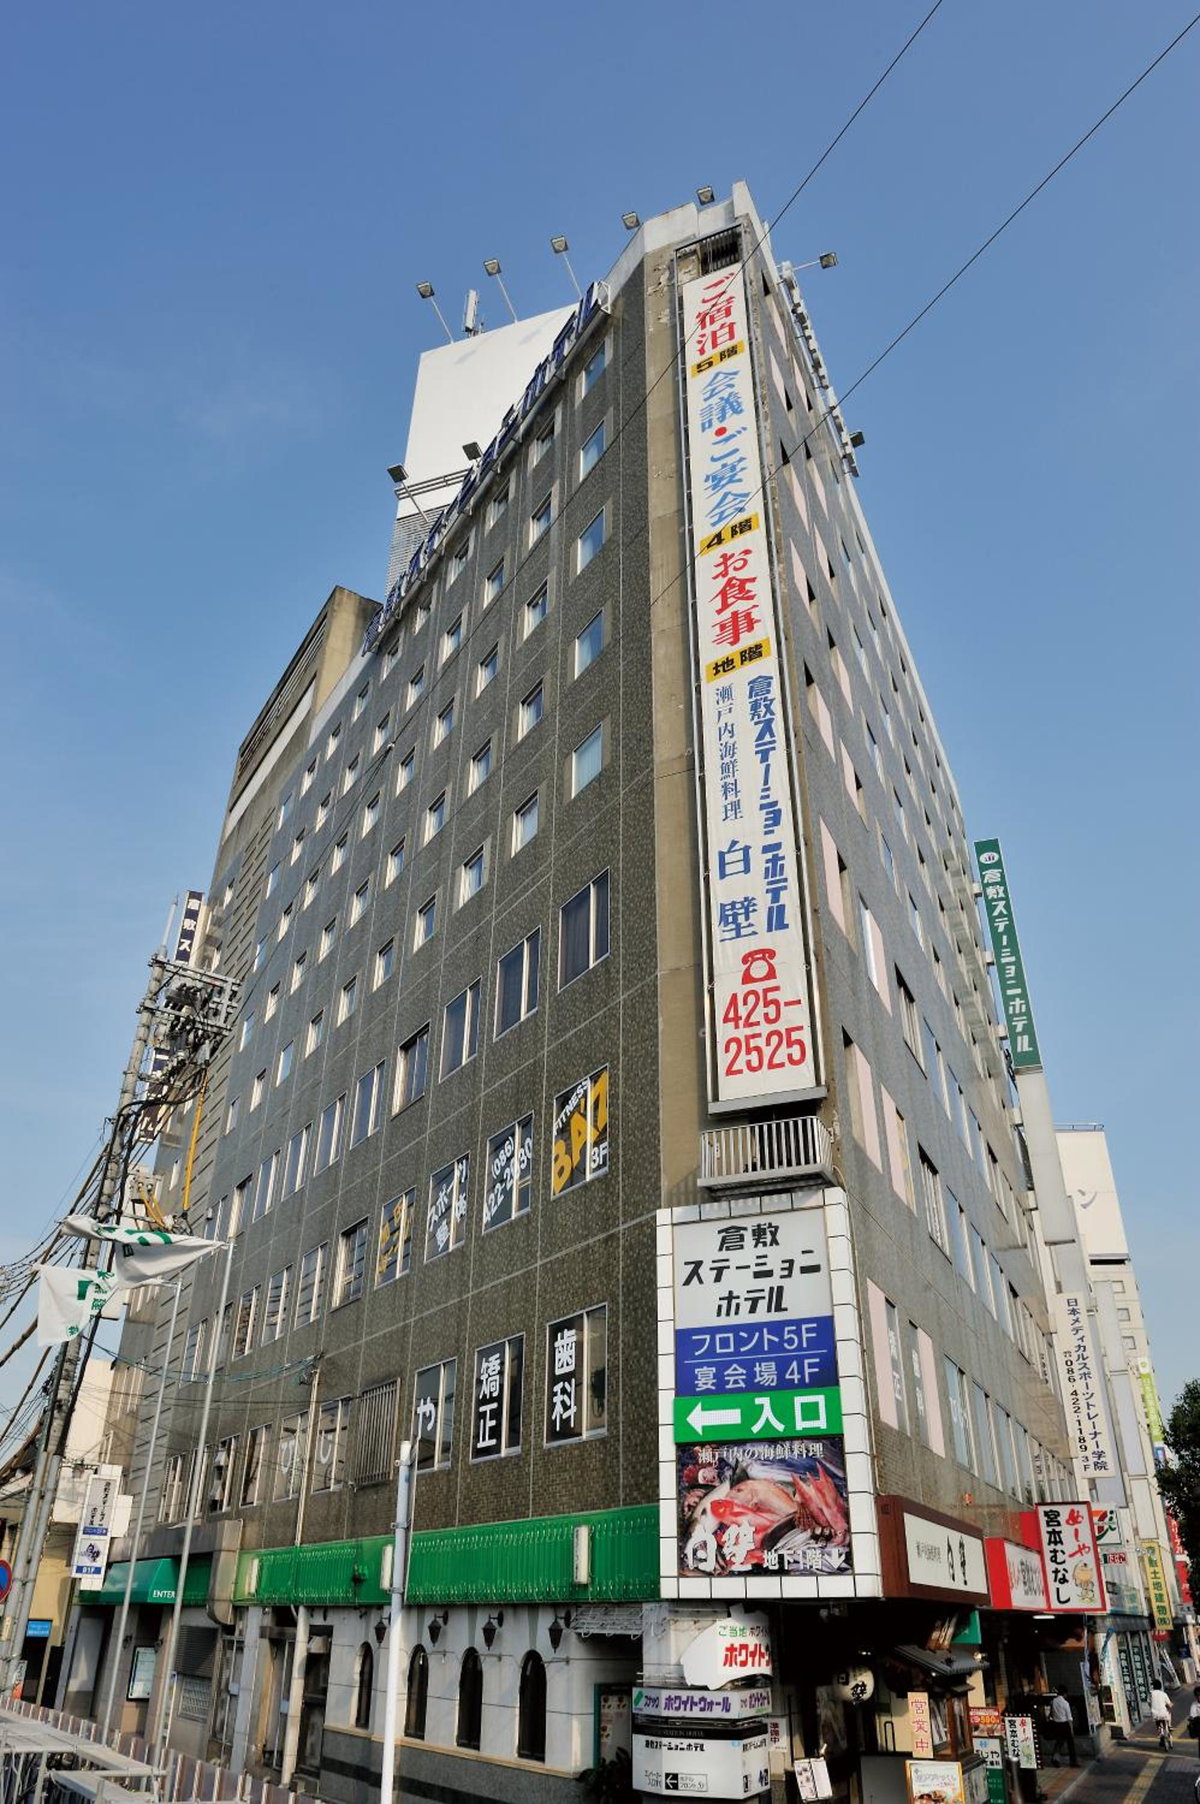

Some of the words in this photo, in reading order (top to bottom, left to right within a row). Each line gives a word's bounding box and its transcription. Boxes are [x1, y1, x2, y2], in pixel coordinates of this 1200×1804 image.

[695, 272, 737, 356] ご宿泊
[696, 346, 739, 374] 5階
[705, 517, 754, 551] 4階
[708, 548, 762, 647] お食事
[711, 642, 764, 677] 地階
[715, 682, 744, 823] 瀬戸内海鮮料理
[717, 839, 759, 943] 白壁
[724, 1024, 808, 1078] 2525
[590, 1141, 610, 1169] 3F
[716, 1221, 781, 1252] 倉敷
[681, 1249, 822, 1287] ステーション
[715, 1284, 789, 1318] ホテル
[476, 1352, 501, 1448] 矯正
[551, 1328, 577, 1432] 歯科
[750, 1394, 828, 1434] 入口
[1043, 1508, 1071, 1606] 宮本むなし
[152, 1589, 176, 1599] ENTER
[663, 1694, 731, 1713] ホワイトウォール
[910, 1697, 930, 1753] 営業中
